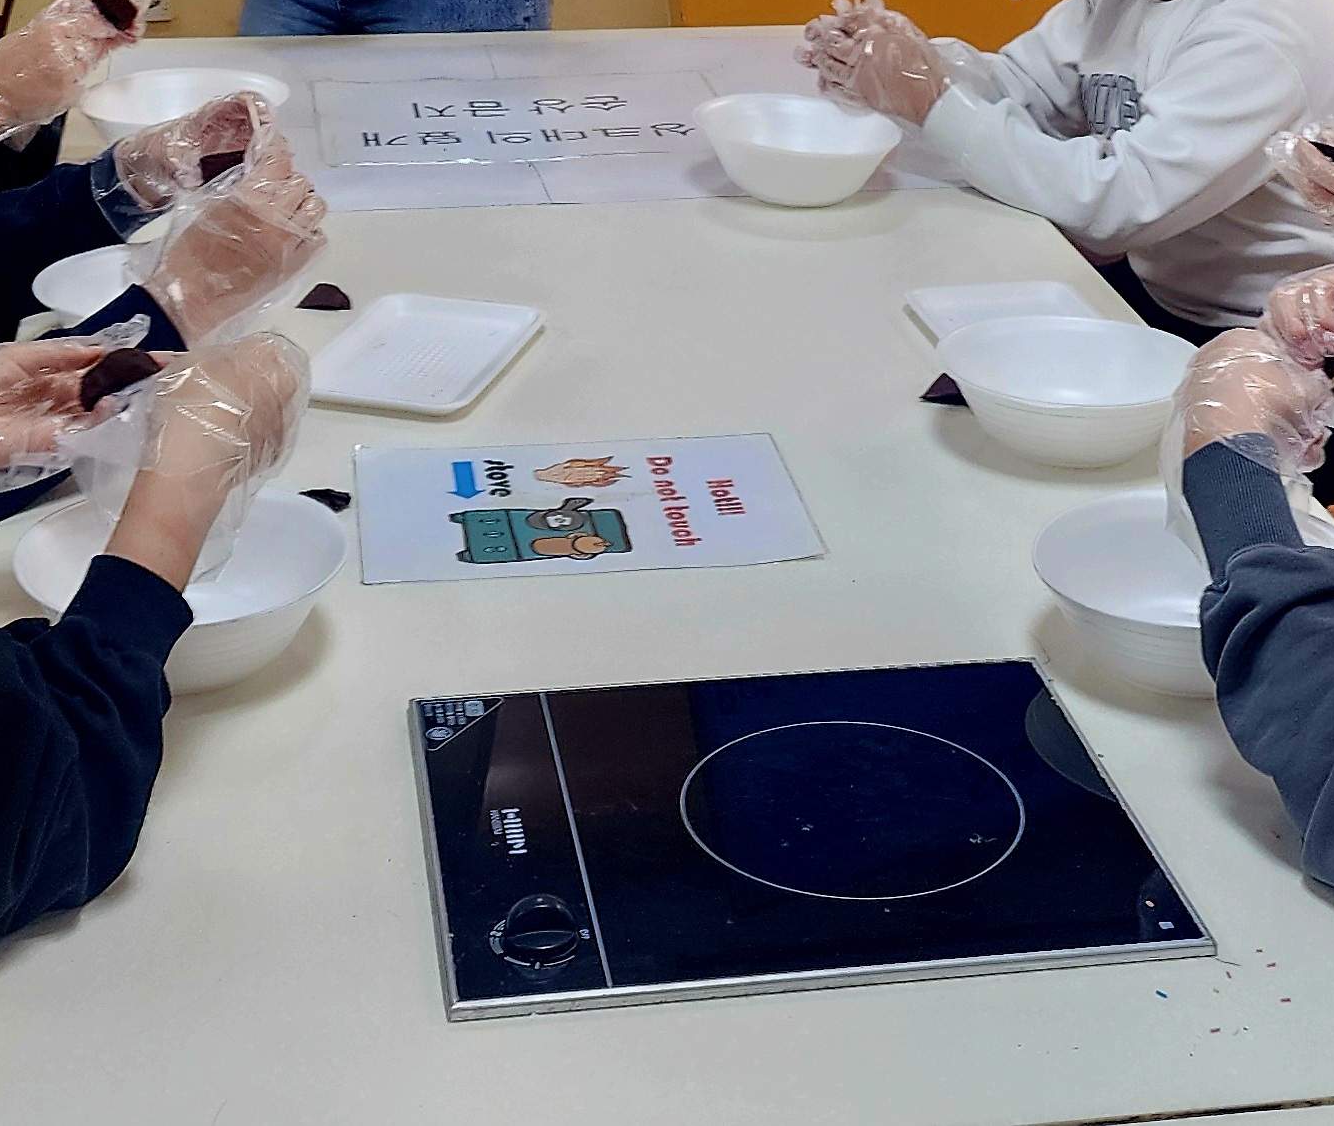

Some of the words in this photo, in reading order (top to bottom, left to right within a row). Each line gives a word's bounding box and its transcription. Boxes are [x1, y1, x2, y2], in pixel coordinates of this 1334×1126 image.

[412, 99, 510, 120] 금지
[530, 94, 627, 116] 손상
[486, 121, 696, 146] 싱크대의
[646, 455, 674, 476] Do
[483, 458, 514, 498] stove
[653, 479, 686, 503] not
[663, 505, 703, 548] touch
